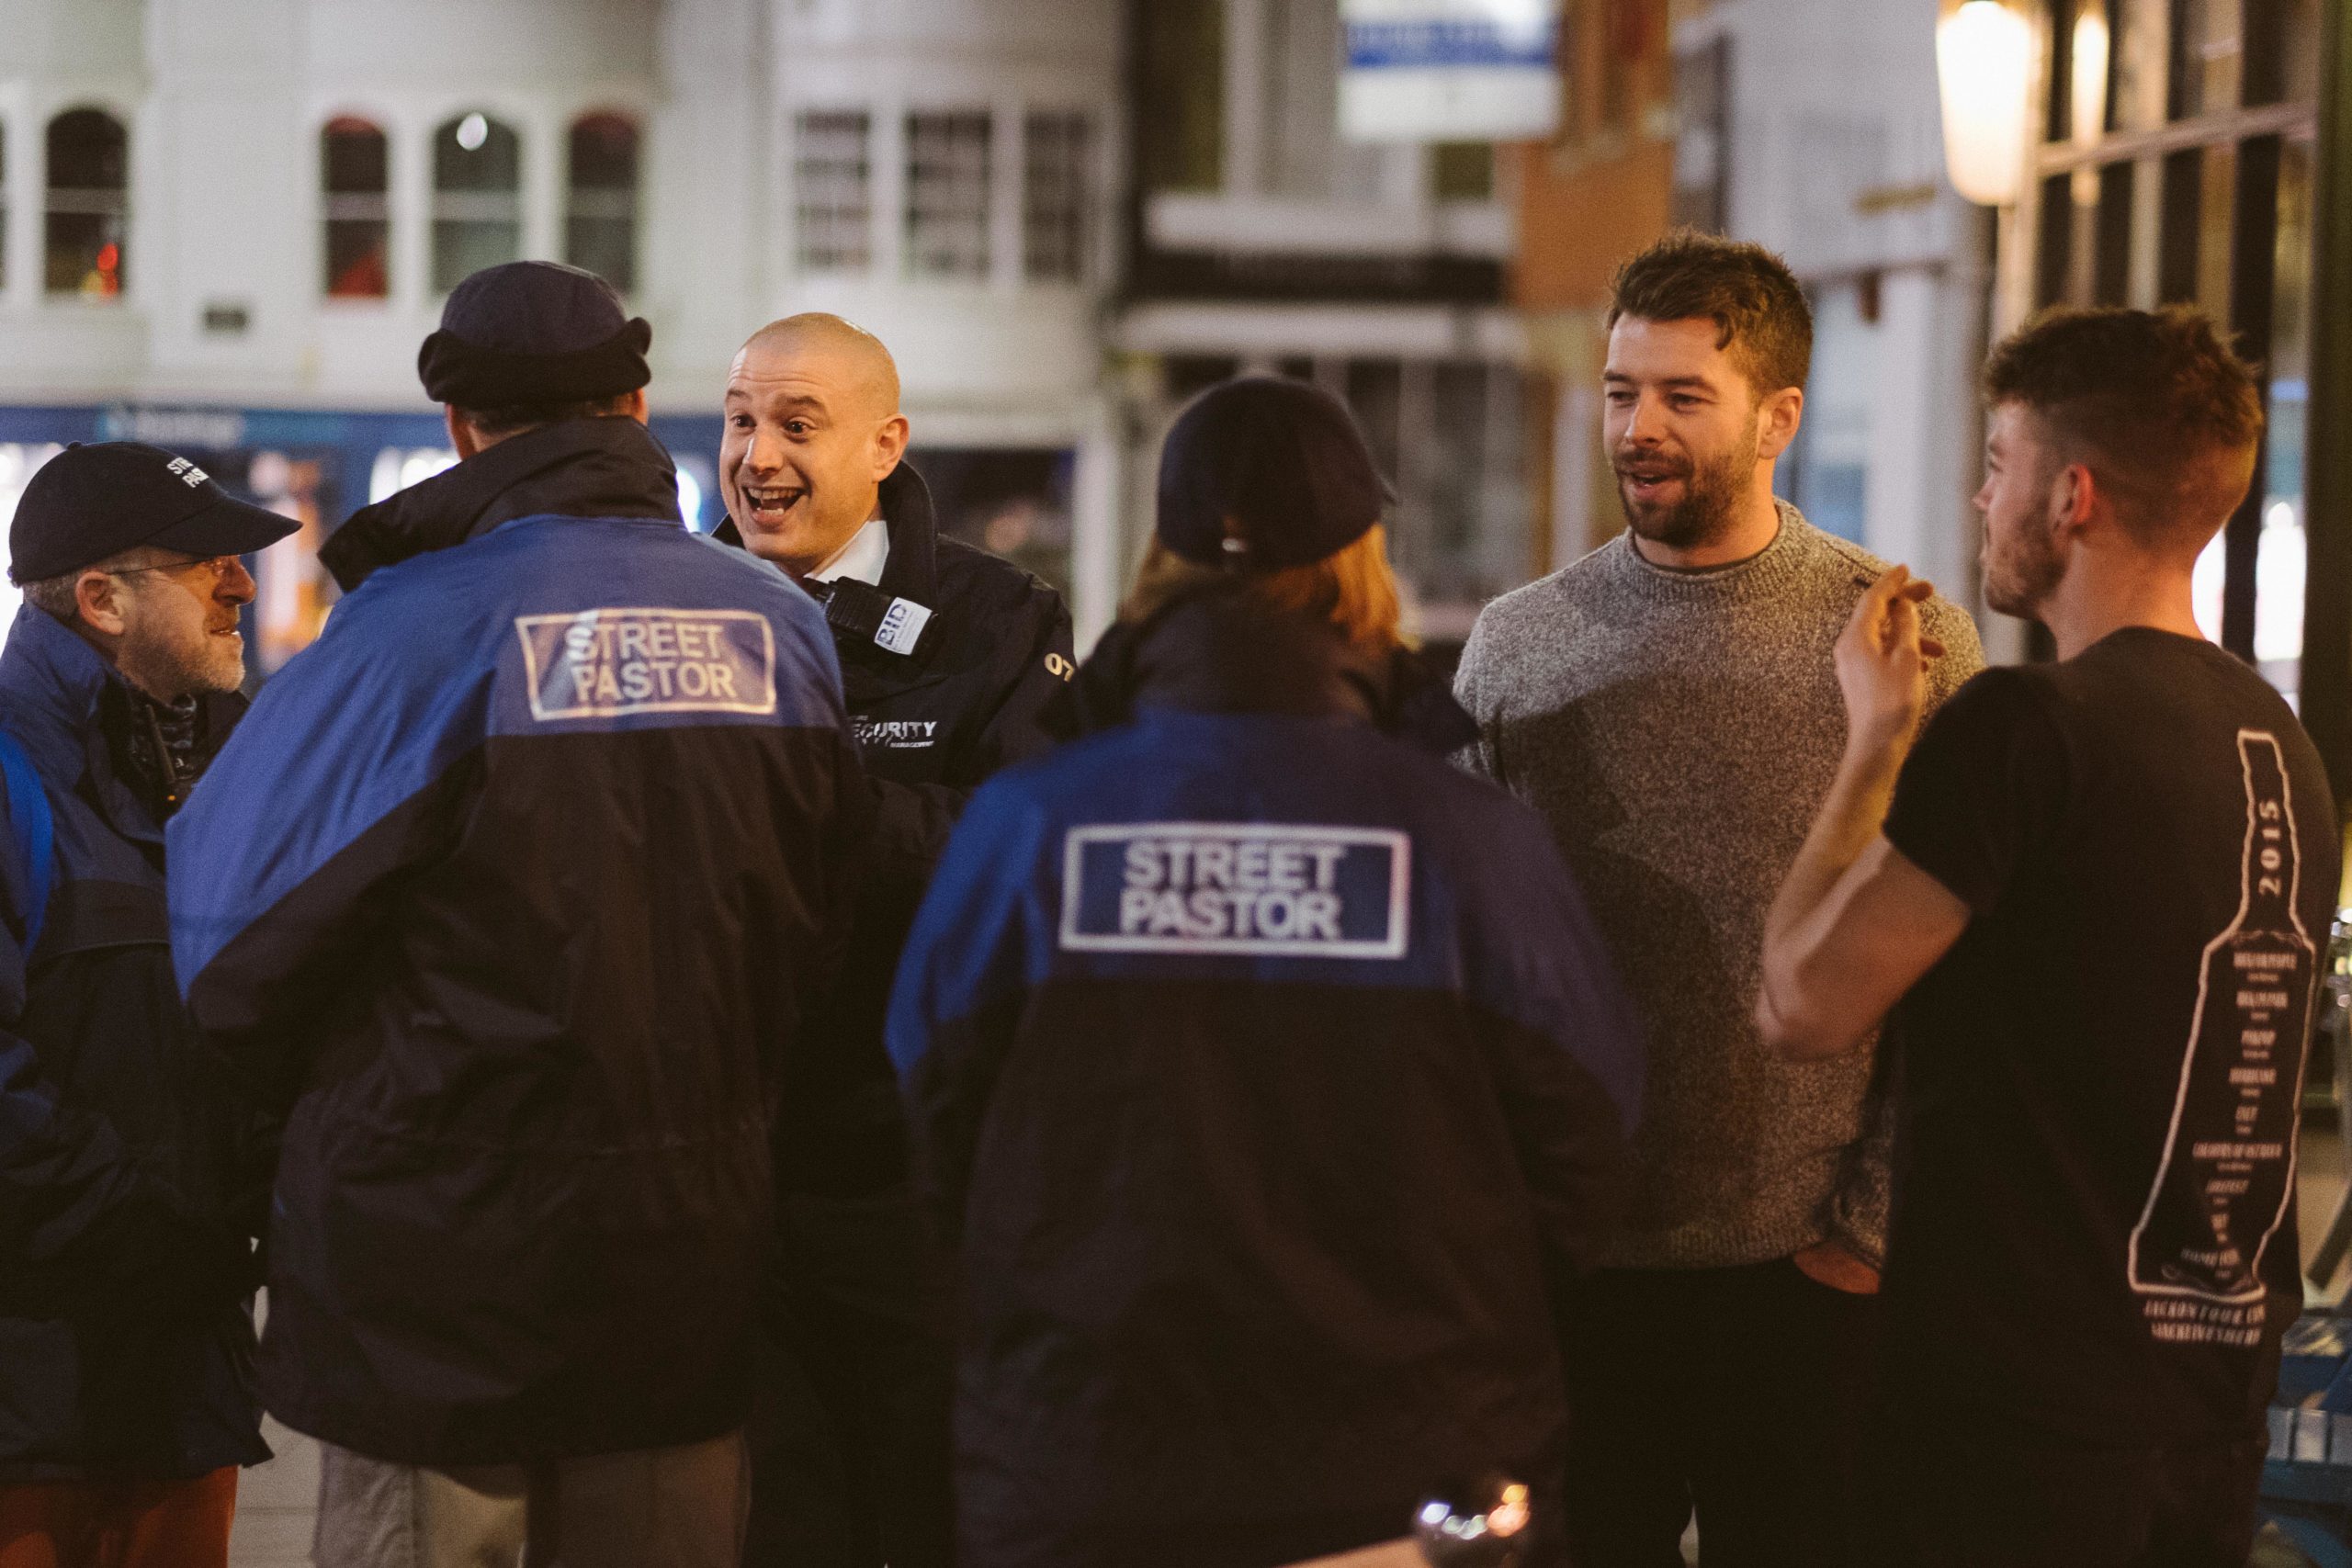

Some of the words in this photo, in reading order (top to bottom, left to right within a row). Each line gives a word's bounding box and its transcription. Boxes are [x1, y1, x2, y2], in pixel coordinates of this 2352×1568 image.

[182, 467, 209, 488] PAS
[565, 621, 724, 661] STREET
[876, 604, 907, 646] BID
[569, 660, 738, 703] PASTOR
[1044, 652, 1074, 682] 07
[852, 721, 937, 739] ECURITY
[1124, 840, 1347, 890] STREET
[2257, 798, 2282, 897] 2015
[1118, 886, 1343, 940] PASTOR
